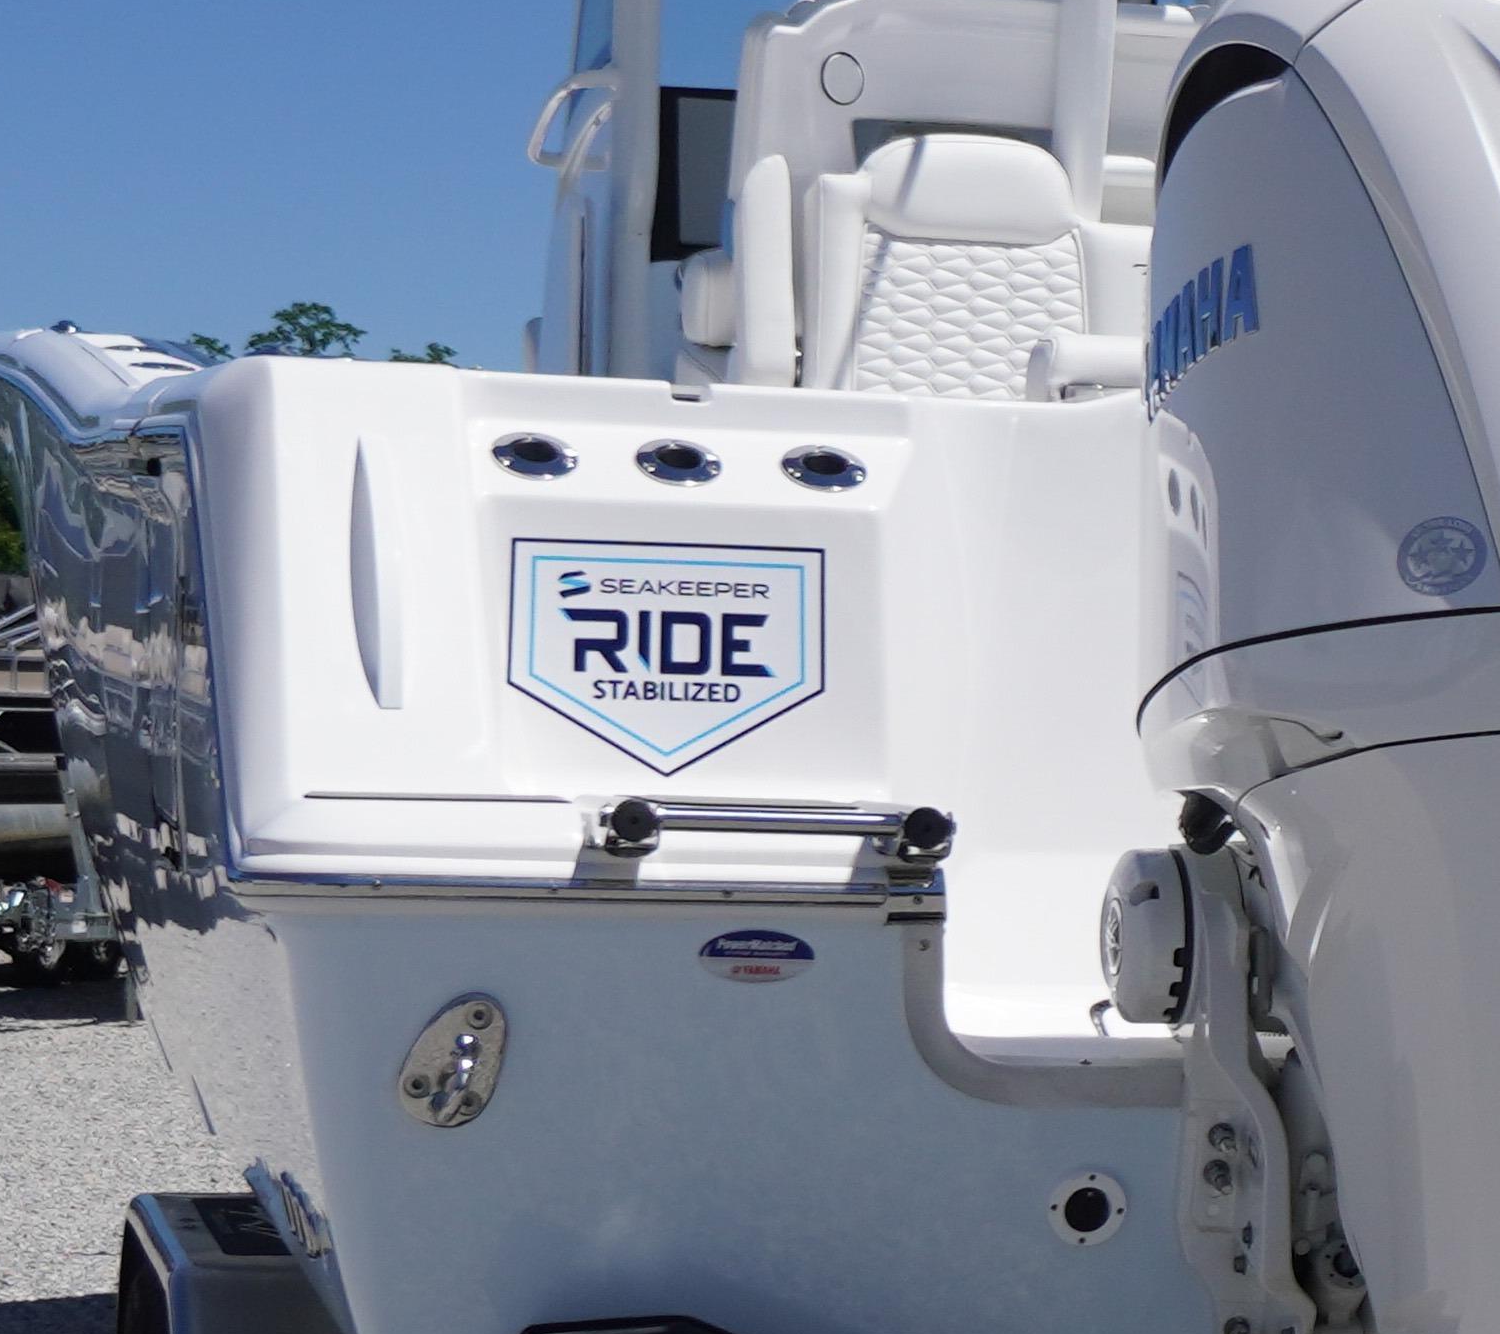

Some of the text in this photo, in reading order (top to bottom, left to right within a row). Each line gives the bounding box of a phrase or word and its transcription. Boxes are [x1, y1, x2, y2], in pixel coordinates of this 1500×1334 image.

[600, 578, 770, 599] SEAKEEPER
[558, 607, 778, 678] RIDE
[593, 679, 741, 703] STABILIZED
